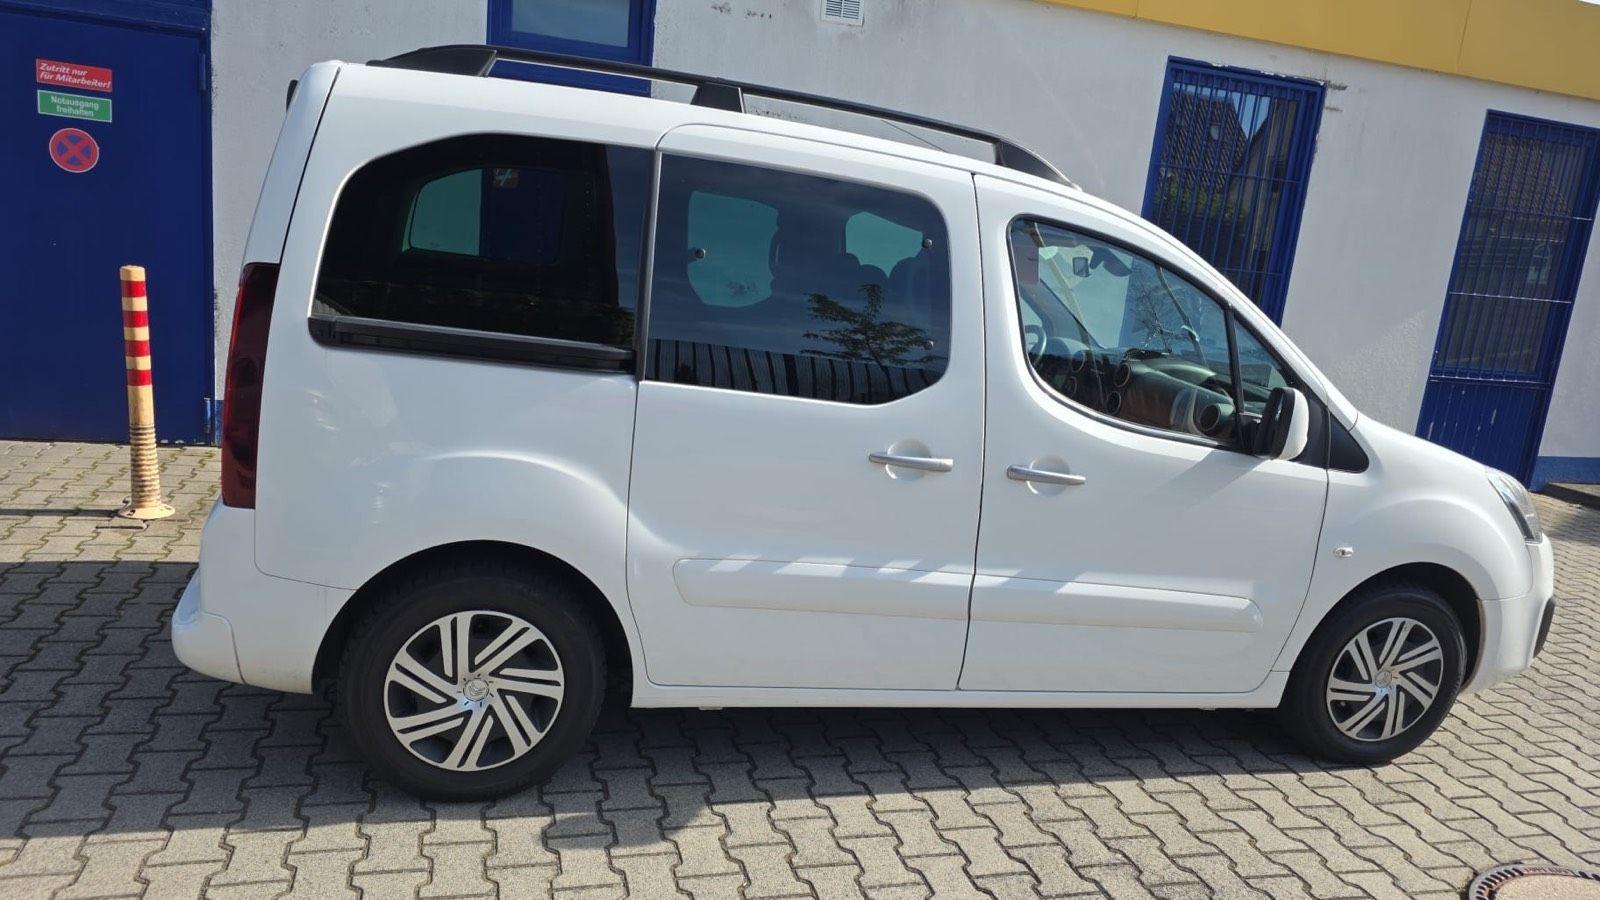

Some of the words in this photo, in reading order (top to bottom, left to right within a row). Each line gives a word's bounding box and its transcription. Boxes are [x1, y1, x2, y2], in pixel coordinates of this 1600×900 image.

[40, 62, 70, 74] Zutritt
[71, 68, 88, 76] nur
[40, 71, 54, 80] für
[55, 74, 111, 88] Mitarbeiter!
[51, 95, 99, 111] Notausgang
[56, 105, 94, 117] freihalten
